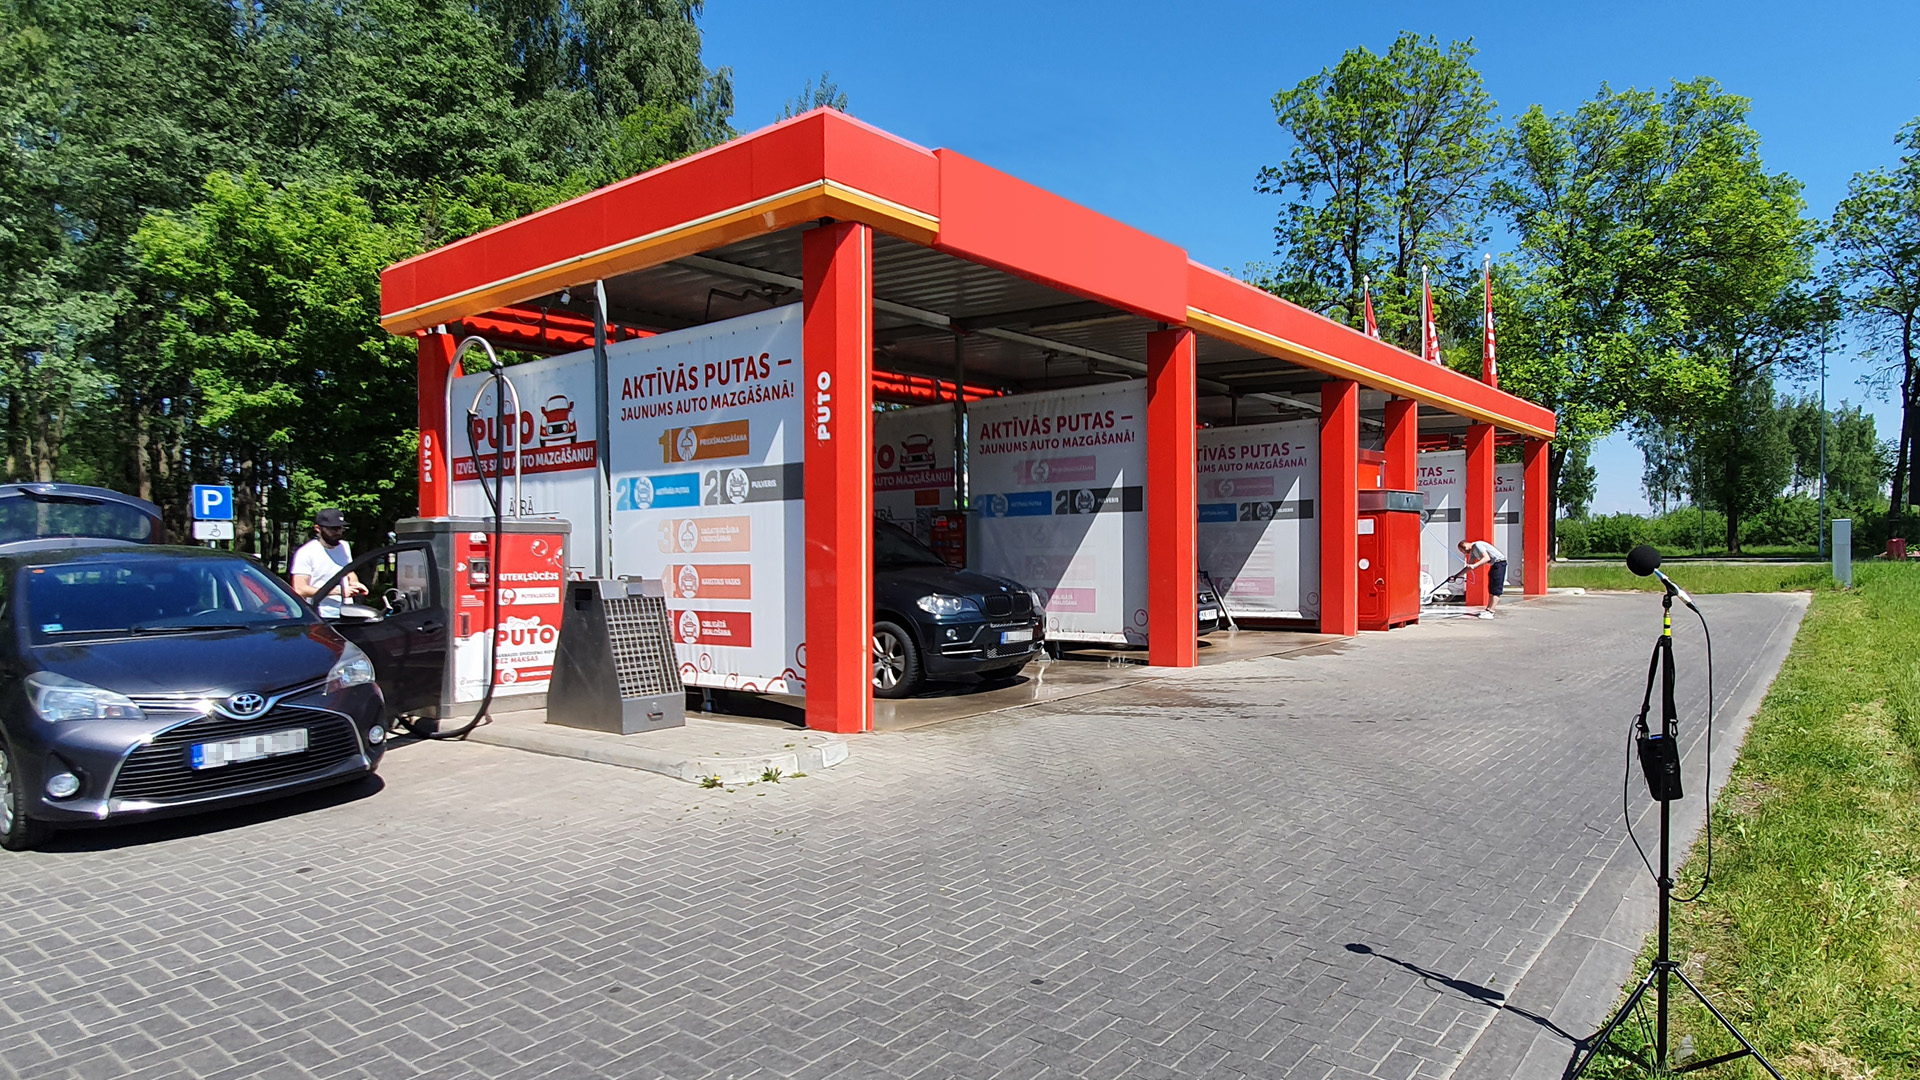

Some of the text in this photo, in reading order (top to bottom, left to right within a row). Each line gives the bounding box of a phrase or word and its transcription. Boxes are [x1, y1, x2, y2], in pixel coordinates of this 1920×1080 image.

[621, 363, 698, 400] AKTĪVĀS
[704, 352, 770, 388] PUTAS
[621, 379, 795, 421] JAUNUMS AUTO MAZGĀŠANĀ!
[817, 371, 831, 441] PUTO
[473, 410, 535, 450] PUTO
[980, 414, 1051, 440] AKTĪVĀS
[1057, 410, 1115, 433] PUTAS
[979, 429, 1135, 455] JAUNUMS AUTO MAZGĀŠANĀ!
[1197, 444, 1236, 461] TĪVĀS
[1241, 442, 1290, 459] PUTAS
[424, 435, 433, 483] PUTO
[456, 447, 593, 475] IZVĒLES SAU ATO MAZGĀŠANU!
[1218, 463, 1243, 473] AUTO
[1418, 467, 1443, 477] TAS
[1418, 478, 1456, 487] ZGĀŠANĀ!
[704, 469, 719, 506] 2
[203, 490, 222, 515] P
[509, 496, 535, 516] ĀRĀ
[874, 507, 894, 521] TRĀ
[1055, 490, 1068, 515] 2
[1240, 502, 1251, 521] 2
[499, 571, 560, 583] UTEKĻSŪCĒJS
[497, 627, 555, 646] PUTO
